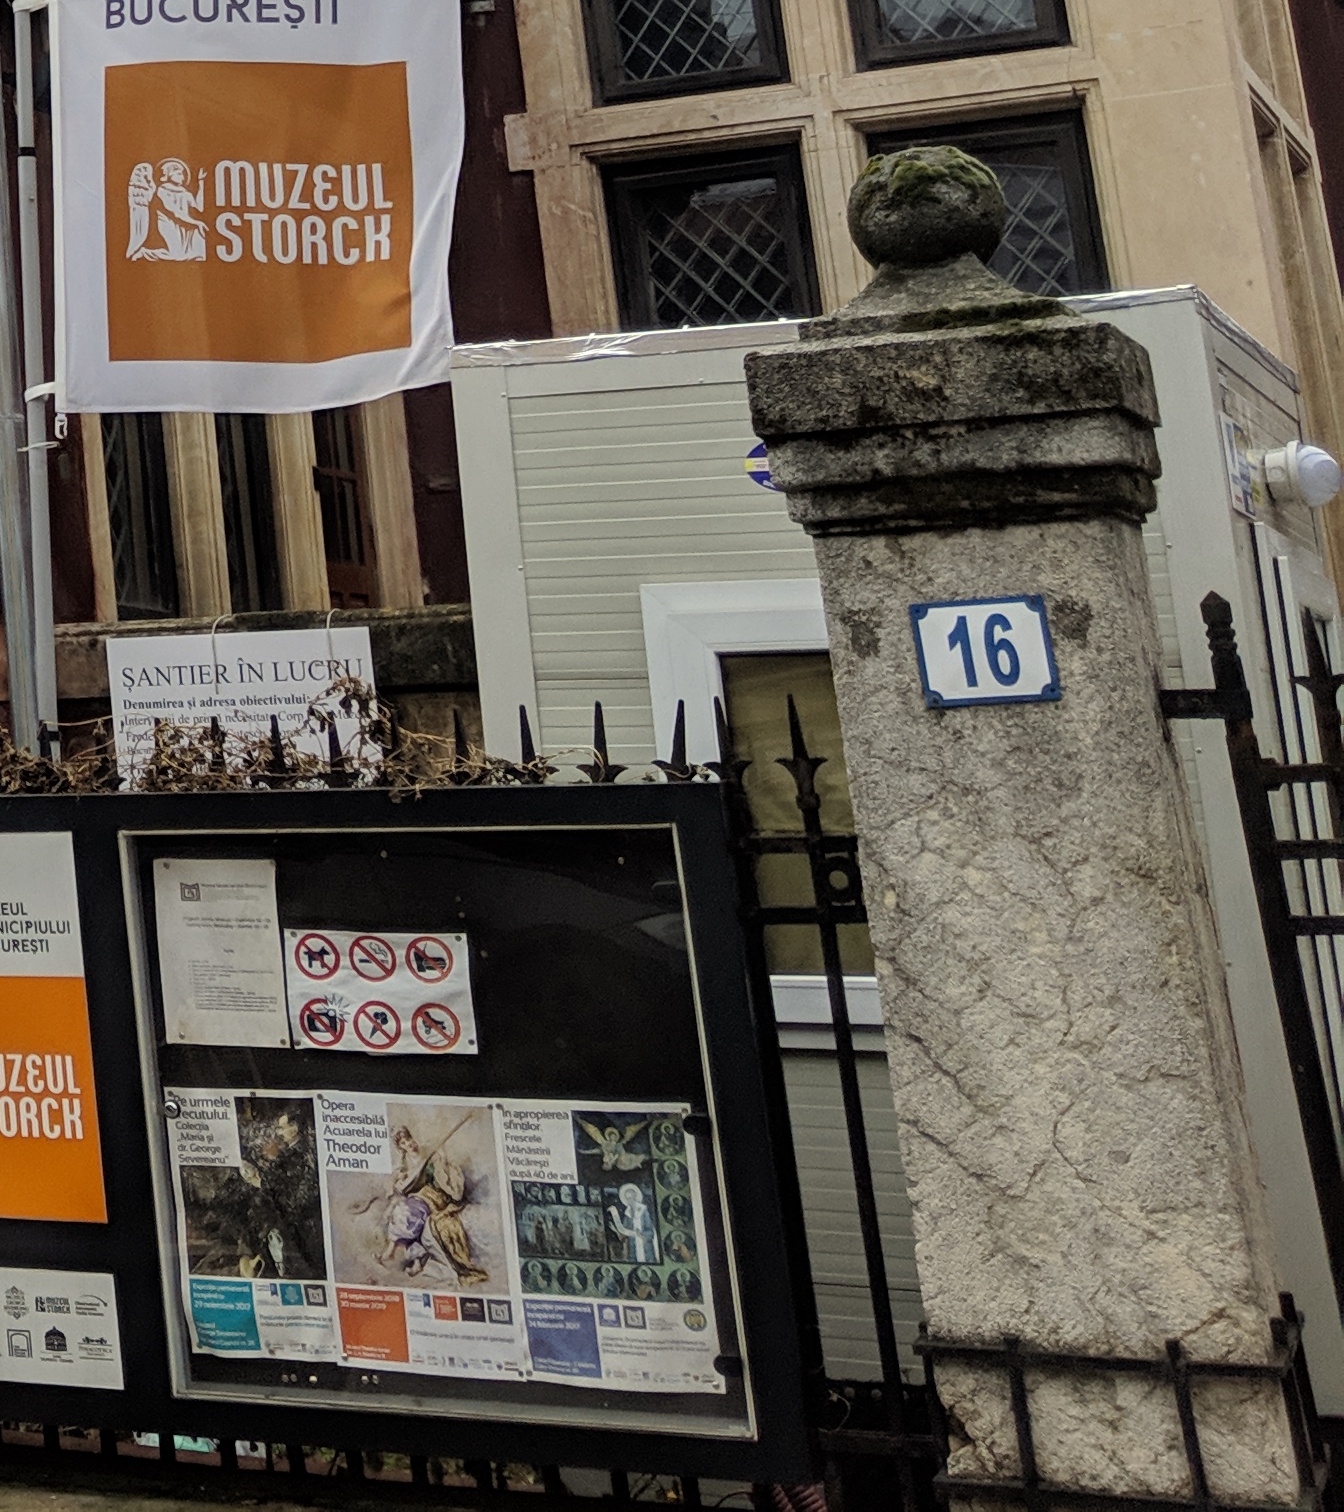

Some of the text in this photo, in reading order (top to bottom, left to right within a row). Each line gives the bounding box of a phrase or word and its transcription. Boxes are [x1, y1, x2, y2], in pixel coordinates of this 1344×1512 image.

[215, 160, 393, 215] MUZEUL
[215, 212, 392, 266] STORCK
[947, 613, 1021, 688] 16
[121, 657, 362, 693] ȘANTIER ÎN LUCRU
[123, 698, 184, 710] Denumirea
[187, 696, 197, 710] și
[199, 697, 236, 708] adresa
[178, 713, 190, 724] de
[189, 1096, 231, 1108] urmele
[321, 1099, 355, 1112] Opera
[513, 1110, 569, 1121] apropierea
[323, 1124, 388, 1139] Acuarela lui
[505, 1133, 542, 1143] Frescele
[190, 1143, 222, 1155] George
[323, 1138, 381, 1155] Theodor
[325, 1154, 369, 1169] Aman
[533, 1170, 545, 1179] 40
[547, 1171, 558, 1180] de
